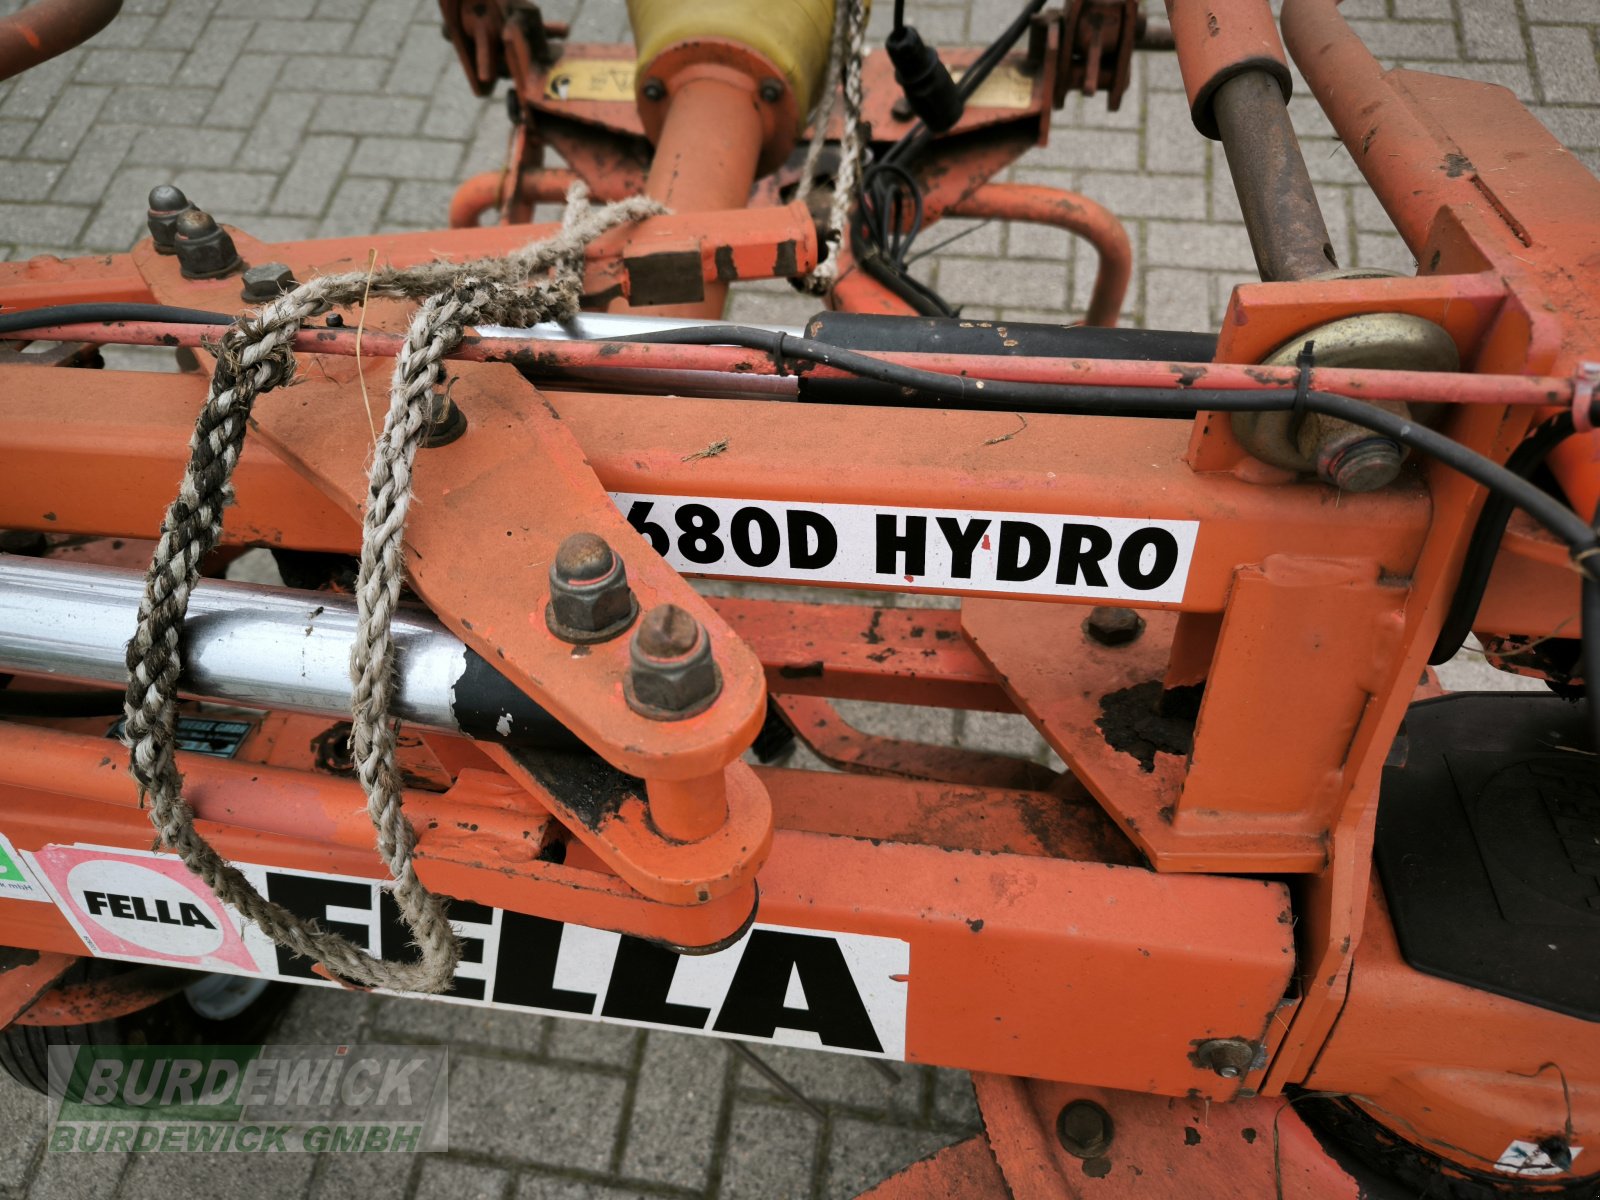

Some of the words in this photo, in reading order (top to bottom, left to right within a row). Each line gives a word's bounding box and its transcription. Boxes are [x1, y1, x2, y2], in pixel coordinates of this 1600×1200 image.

[625, 500, 838, 570] 680D
[875, 513, 1179, 591] HYDRO
[83, 890, 217, 930] FELLA
[266, 872, 885, 1054] FELLA
